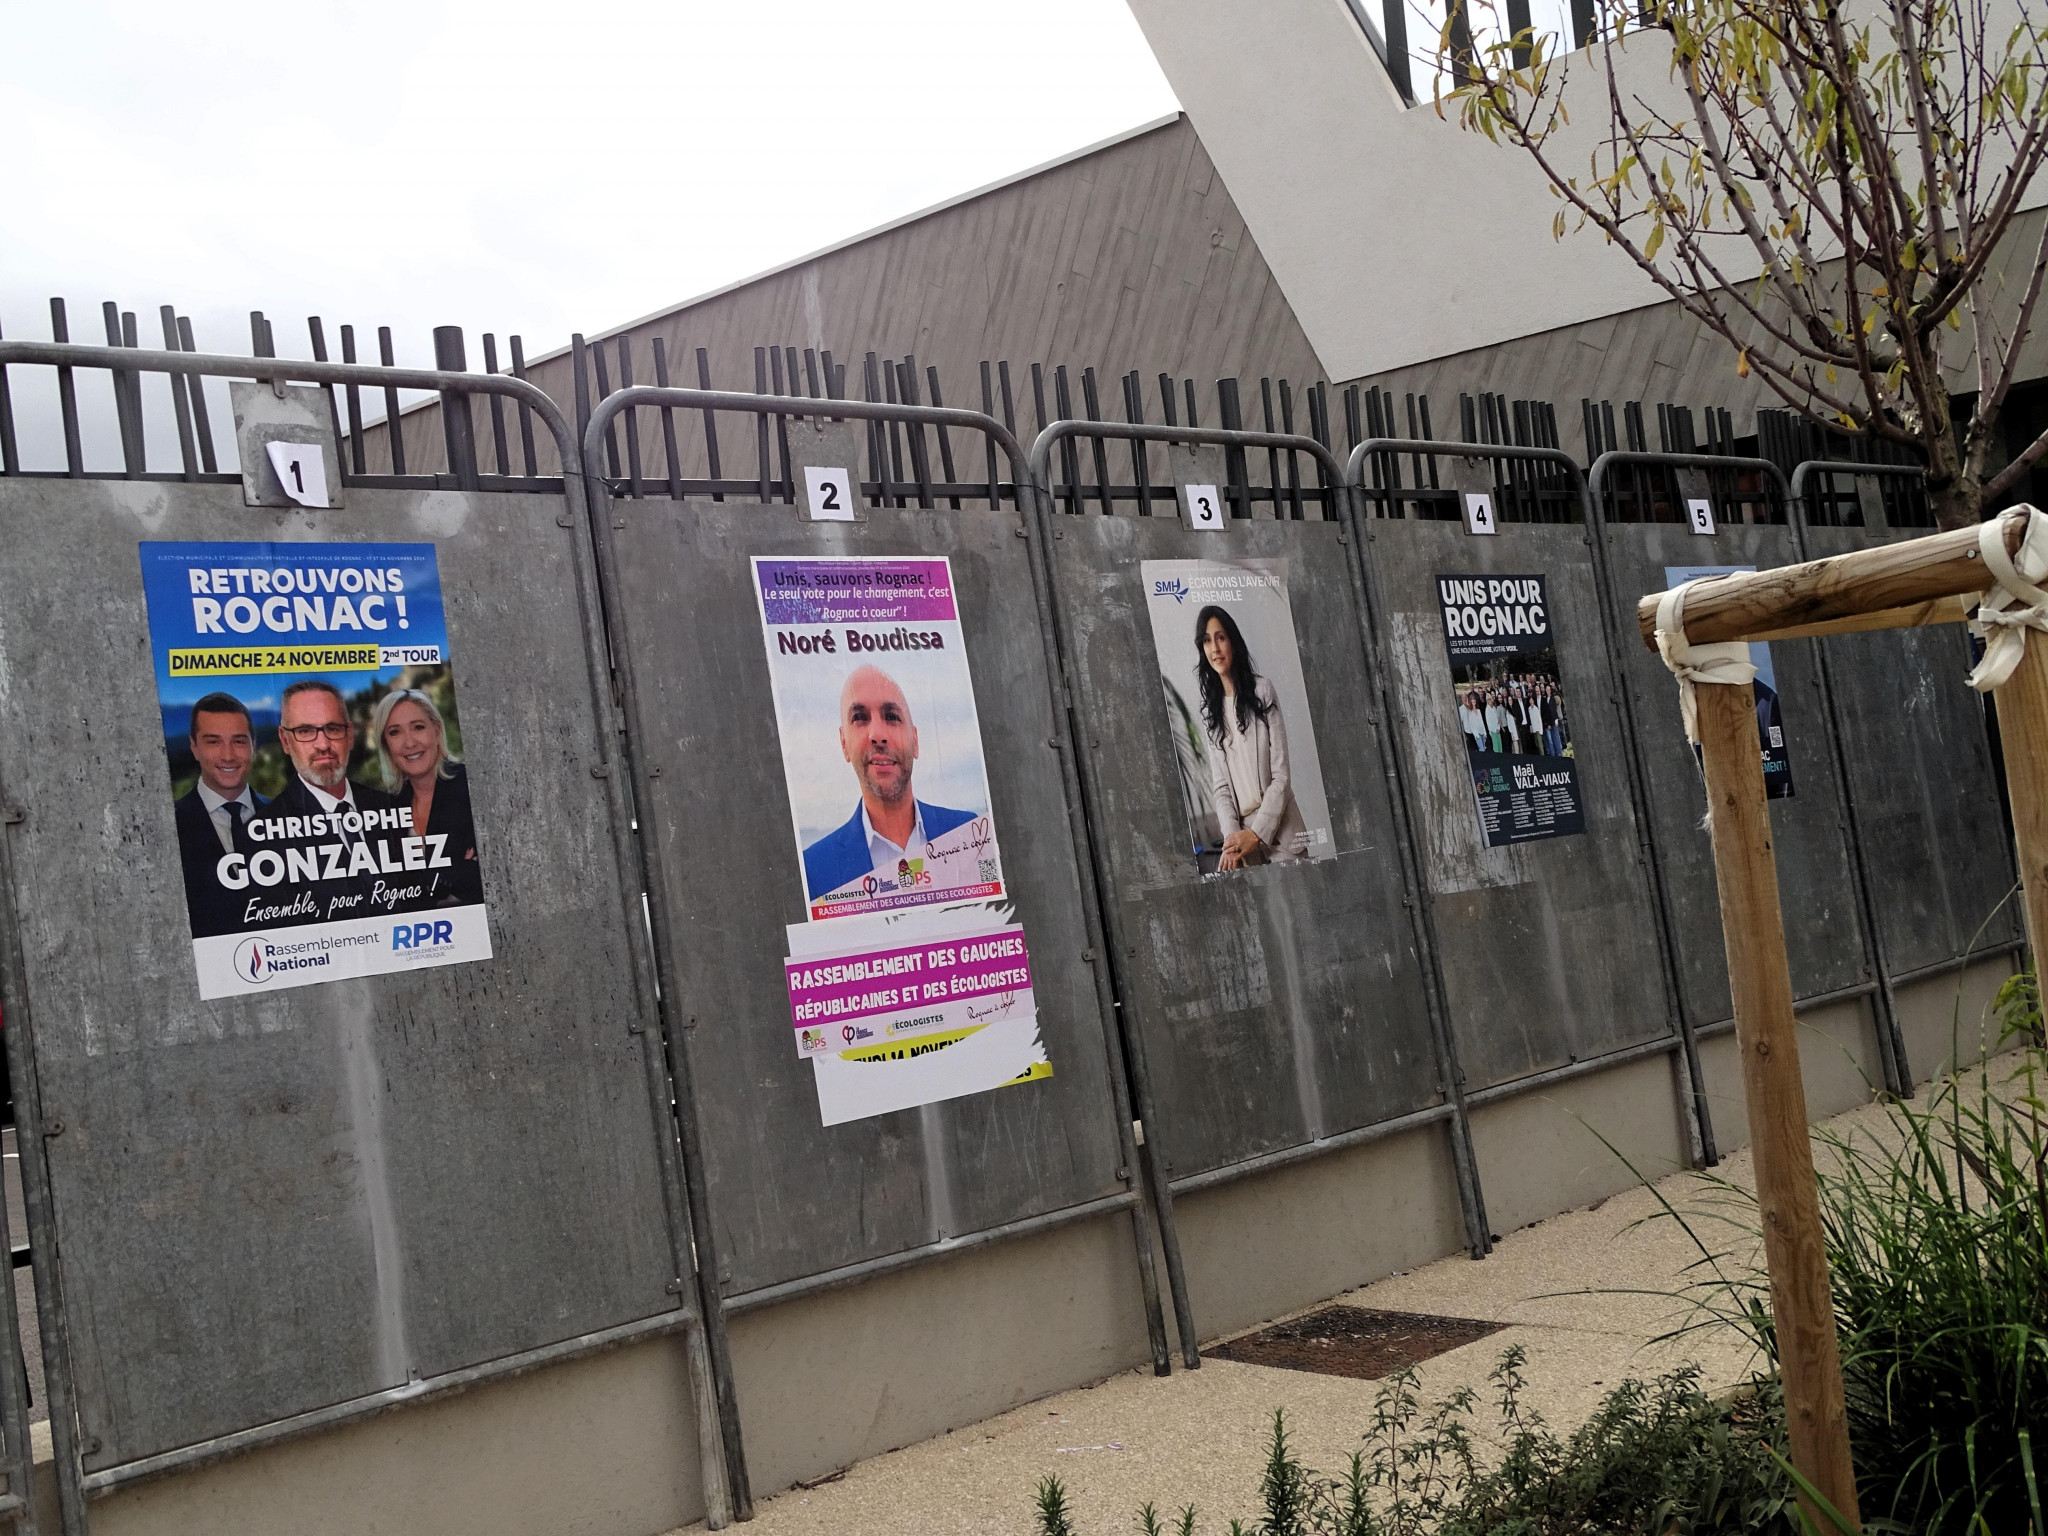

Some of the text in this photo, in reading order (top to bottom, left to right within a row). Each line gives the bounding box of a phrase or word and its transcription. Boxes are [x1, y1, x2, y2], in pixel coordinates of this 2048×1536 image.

[290, 461, 304, 493] 1
[820, 482, 840, 510] 2
[1198, 497, 1212, 521] 3
[1476, 505, 1487, 525] 4
[1697, 509, 1707, 527] 5
[188, 568, 404, 594] RETROUVONS
[773, 571, 812, 588] Unis,
[814, 573, 872, 586] sauvons
[875, 571, 925, 589] Rognac
[1155, 580, 1178, 593] SMH
[1188, 574, 1280, 589] ÉCRIVONS L'AVENIR
[764, 588, 777, 600] Le
[779, 587, 800, 600] seul
[802, 588, 825, 599] vote
[827, 589, 851, 602] pour
[853, 587, 862, 599] le
[864, 587, 927, 601] changement,
[1190, 590, 1243, 603] ENSEMBLE
[1440, 580, 1542, 605] UNIS POUR
[192, 595, 388, 634] ROGNAC
[823, 606, 860, 622] Rognac
[862, 605, 868, 618] à
[1445, 605, 1546, 637] ROGNAC
[776, 627, 945, 655] Noré Boudissa
[172, 649, 439, 670] DIMANCHE 24 NOVEMBRE 2nd TOUR
[1761, 750, 1771, 761] AC
[1490, 768, 1501, 776] UNIS
[1491, 776, 1504, 784] POUR
[1512, 763, 1535, 778] Maël
[1515, 771, 1571, 790] VALA-VIAUX
[1492, 783, 1511, 792] ROGNAC
[247, 806, 414, 841] CHRISTOPHE
[216, 833, 452, 890] GONZALEZ
[914, 871, 932, 885] PS
[243, 891, 320, 924] Ensemble,
[327, 892, 363, 920] pour
[371, 879, 422, 910] Rognac
[818, 885, 994, 916] RASSEMBLEMENT DES GAUCHES ET DES ECOLOGISTES
[265, 931, 380, 957] Rassemblement
[392, 920, 453, 950] RPR
[267, 952, 330, 973] National
[790, 938, 1024, 991] RASSEMBLEMENT DES GAUCHES
[795, 968, 1028, 1021] RÉPUBLICAINES ET DES ÉCOLOGISTES
[895, 1014, 944, 1030] ÉCOLOGISTES
[814, 1037, 827, 1048] PS
